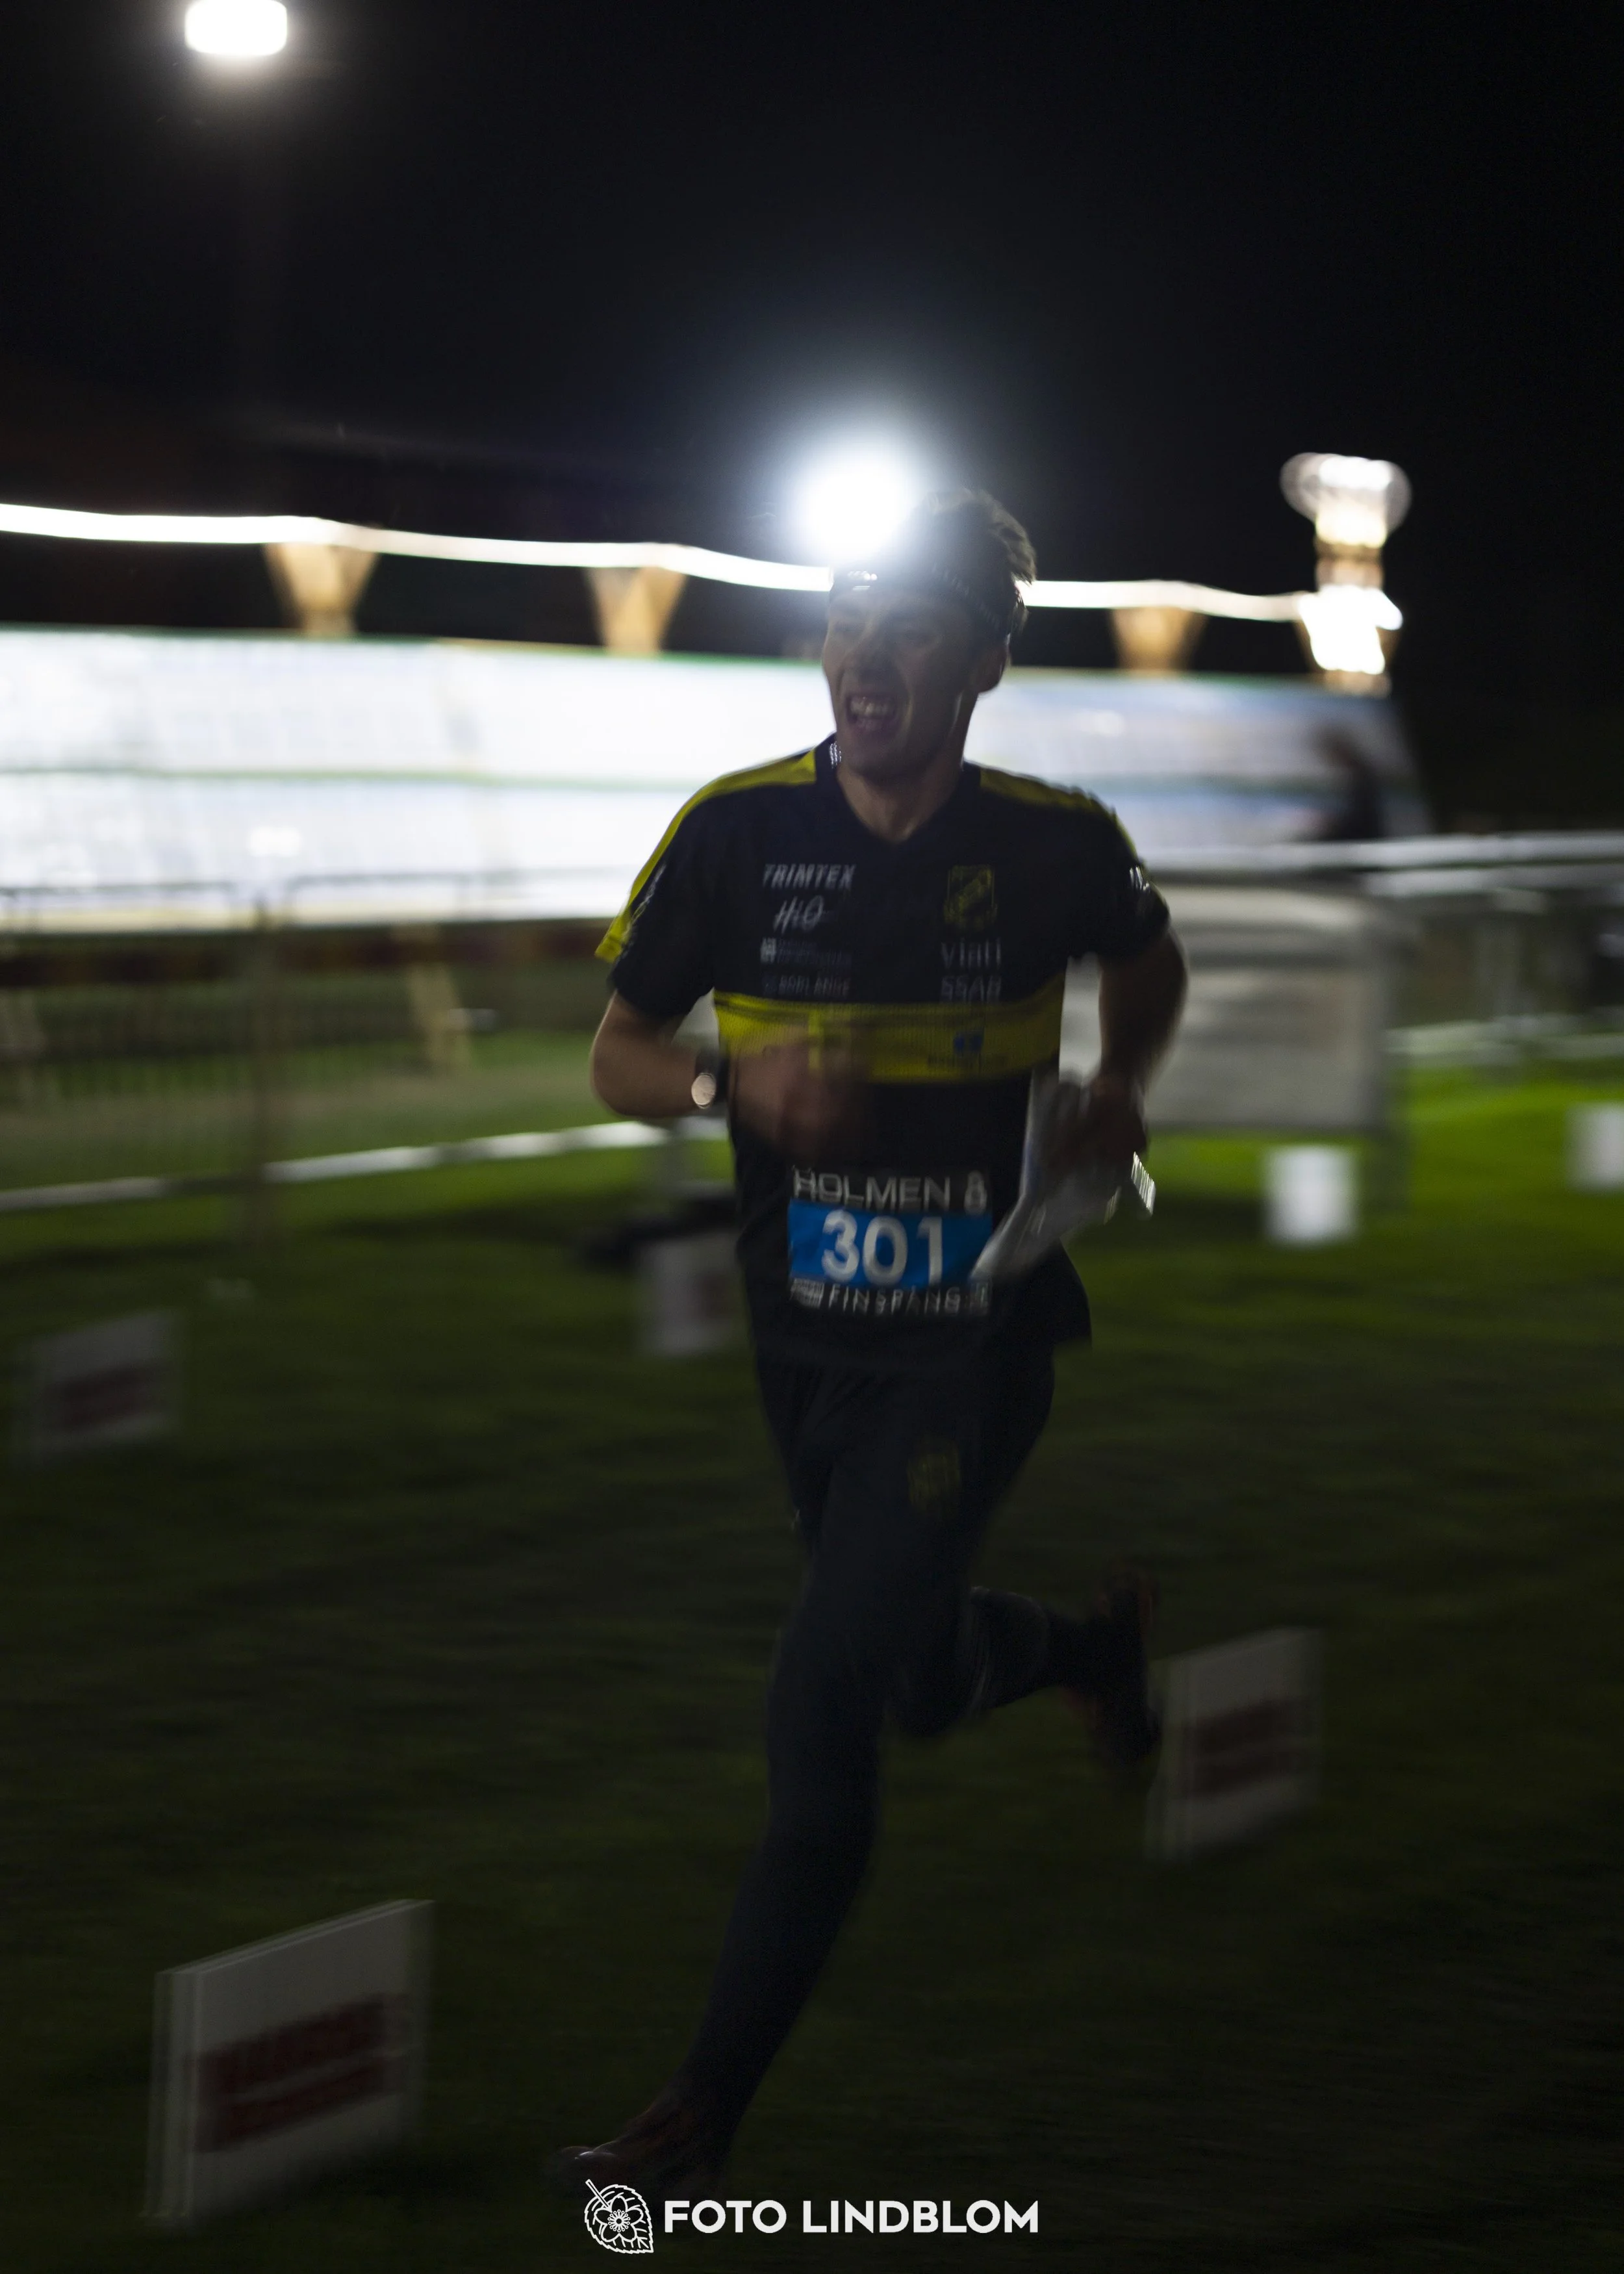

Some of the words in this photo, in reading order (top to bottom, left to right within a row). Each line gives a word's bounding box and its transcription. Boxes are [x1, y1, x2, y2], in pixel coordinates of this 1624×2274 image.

[762, 863, 857, 890] TRIMTEX
[792, 1166, 950, 1212] HOLMEN
[820, 1208, 944, 1287] 301
